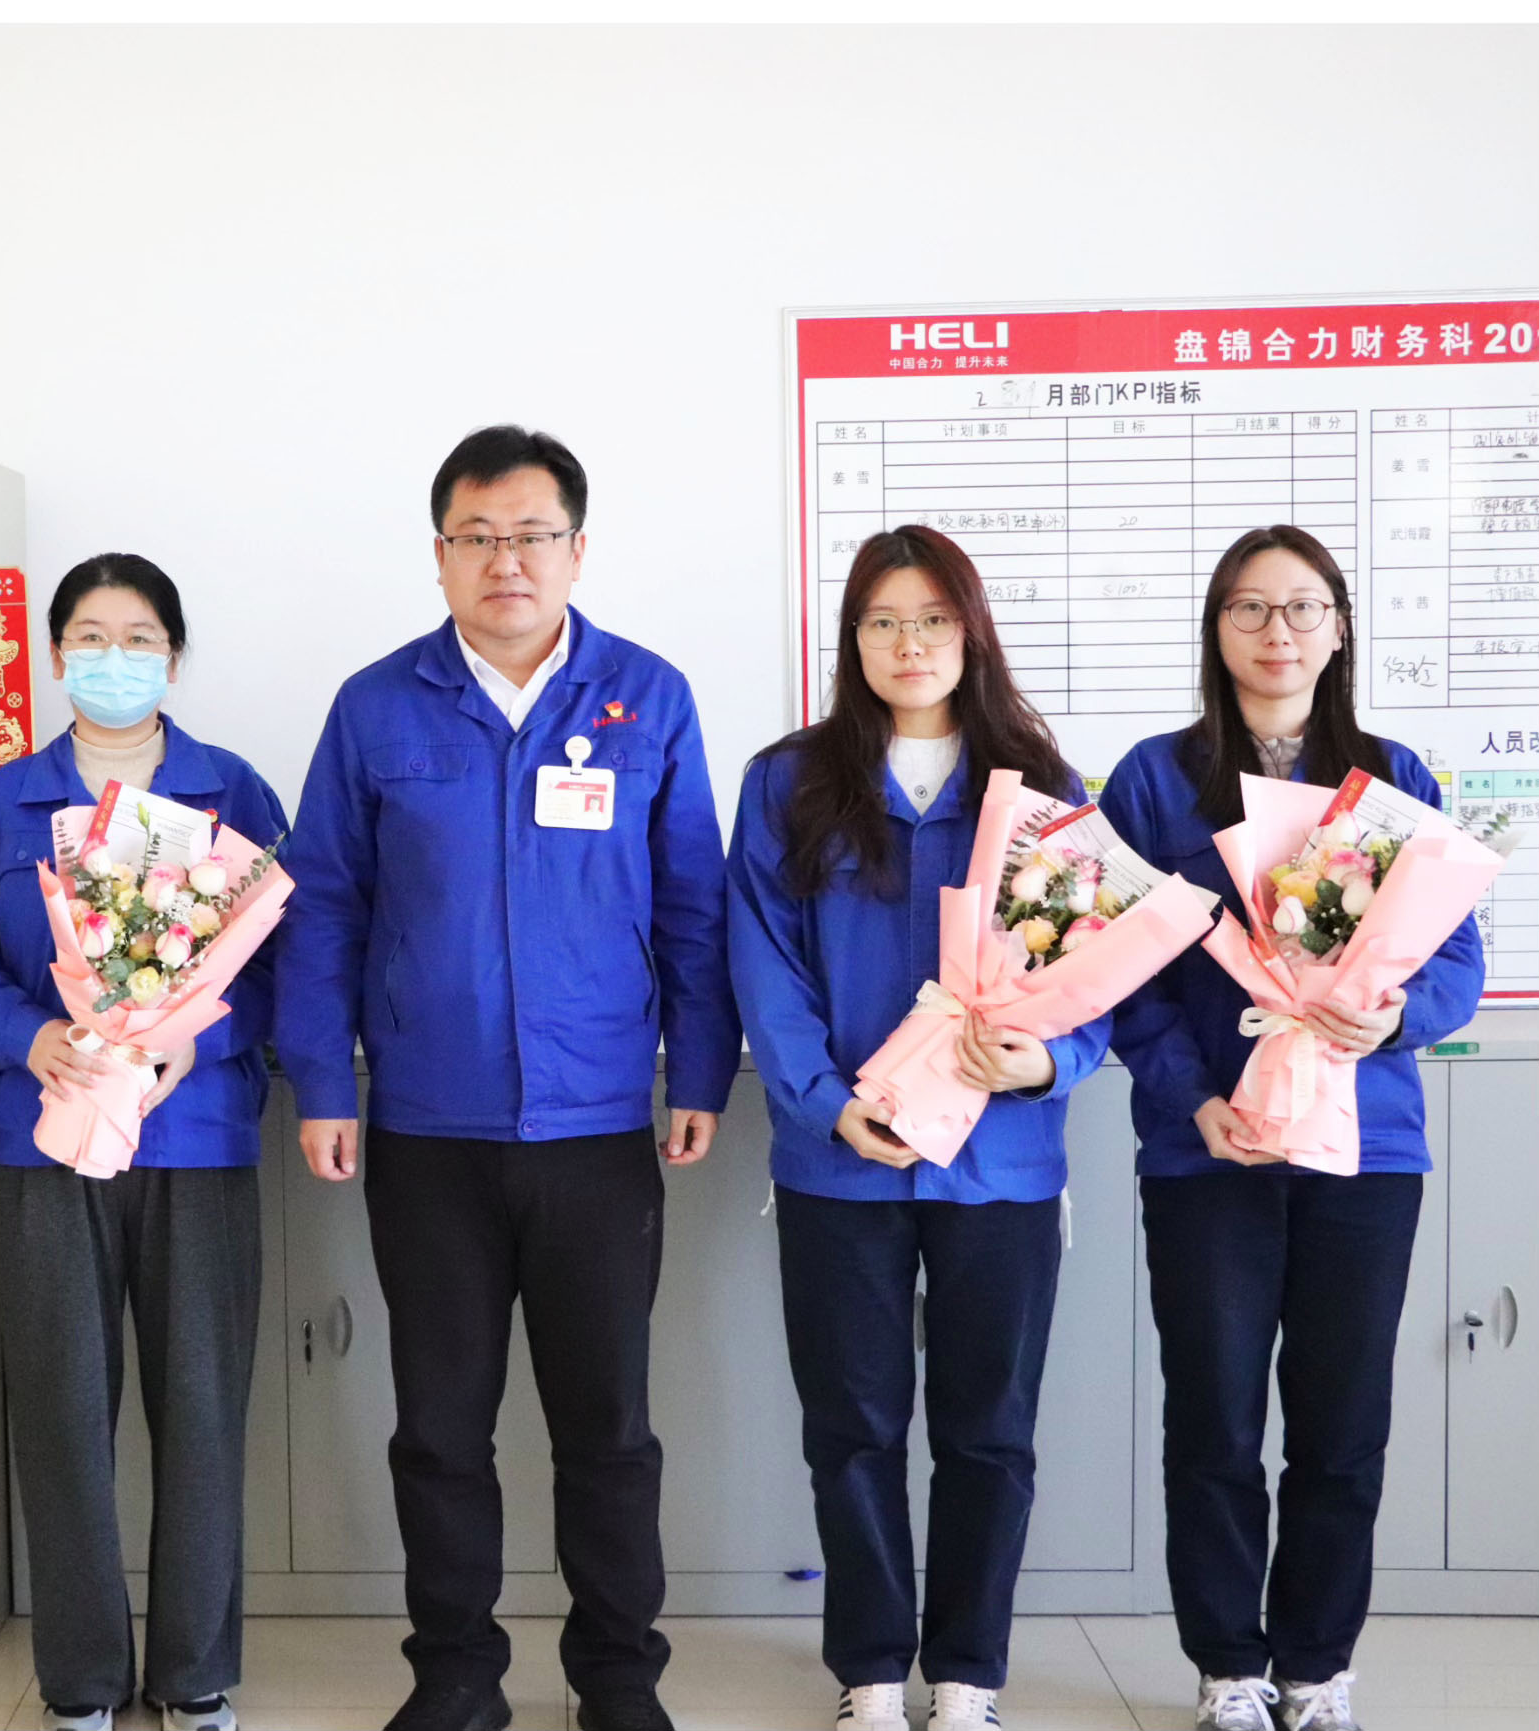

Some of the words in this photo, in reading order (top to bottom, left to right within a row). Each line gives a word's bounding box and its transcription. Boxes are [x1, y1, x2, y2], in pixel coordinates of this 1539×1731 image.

[890, 321, 1009, 350] HELI
[1173, 321, 1539, 364] 盘锦合力财务科20
[889, 357, 943, 370] 中国合力
[955, 355, 1009, 369] 提升未来
[1046, 380, 1202, 407] 月部门KPI指标
[1112, 420, 1146, 434] 目标
[1234, 416, 1280, 431] 月结果
[1307, 415, 1341, 430] 得分
[1394, 413, 1428, 428] 姓名
[833, 425, 868, 440] 姓名
[943, 423, 1009, 438] 计划事项
[832, 470, 870, 485] 姜雪
[1119, 515, 1139, 529] 20
[831, 539, 862, 554] 武海
